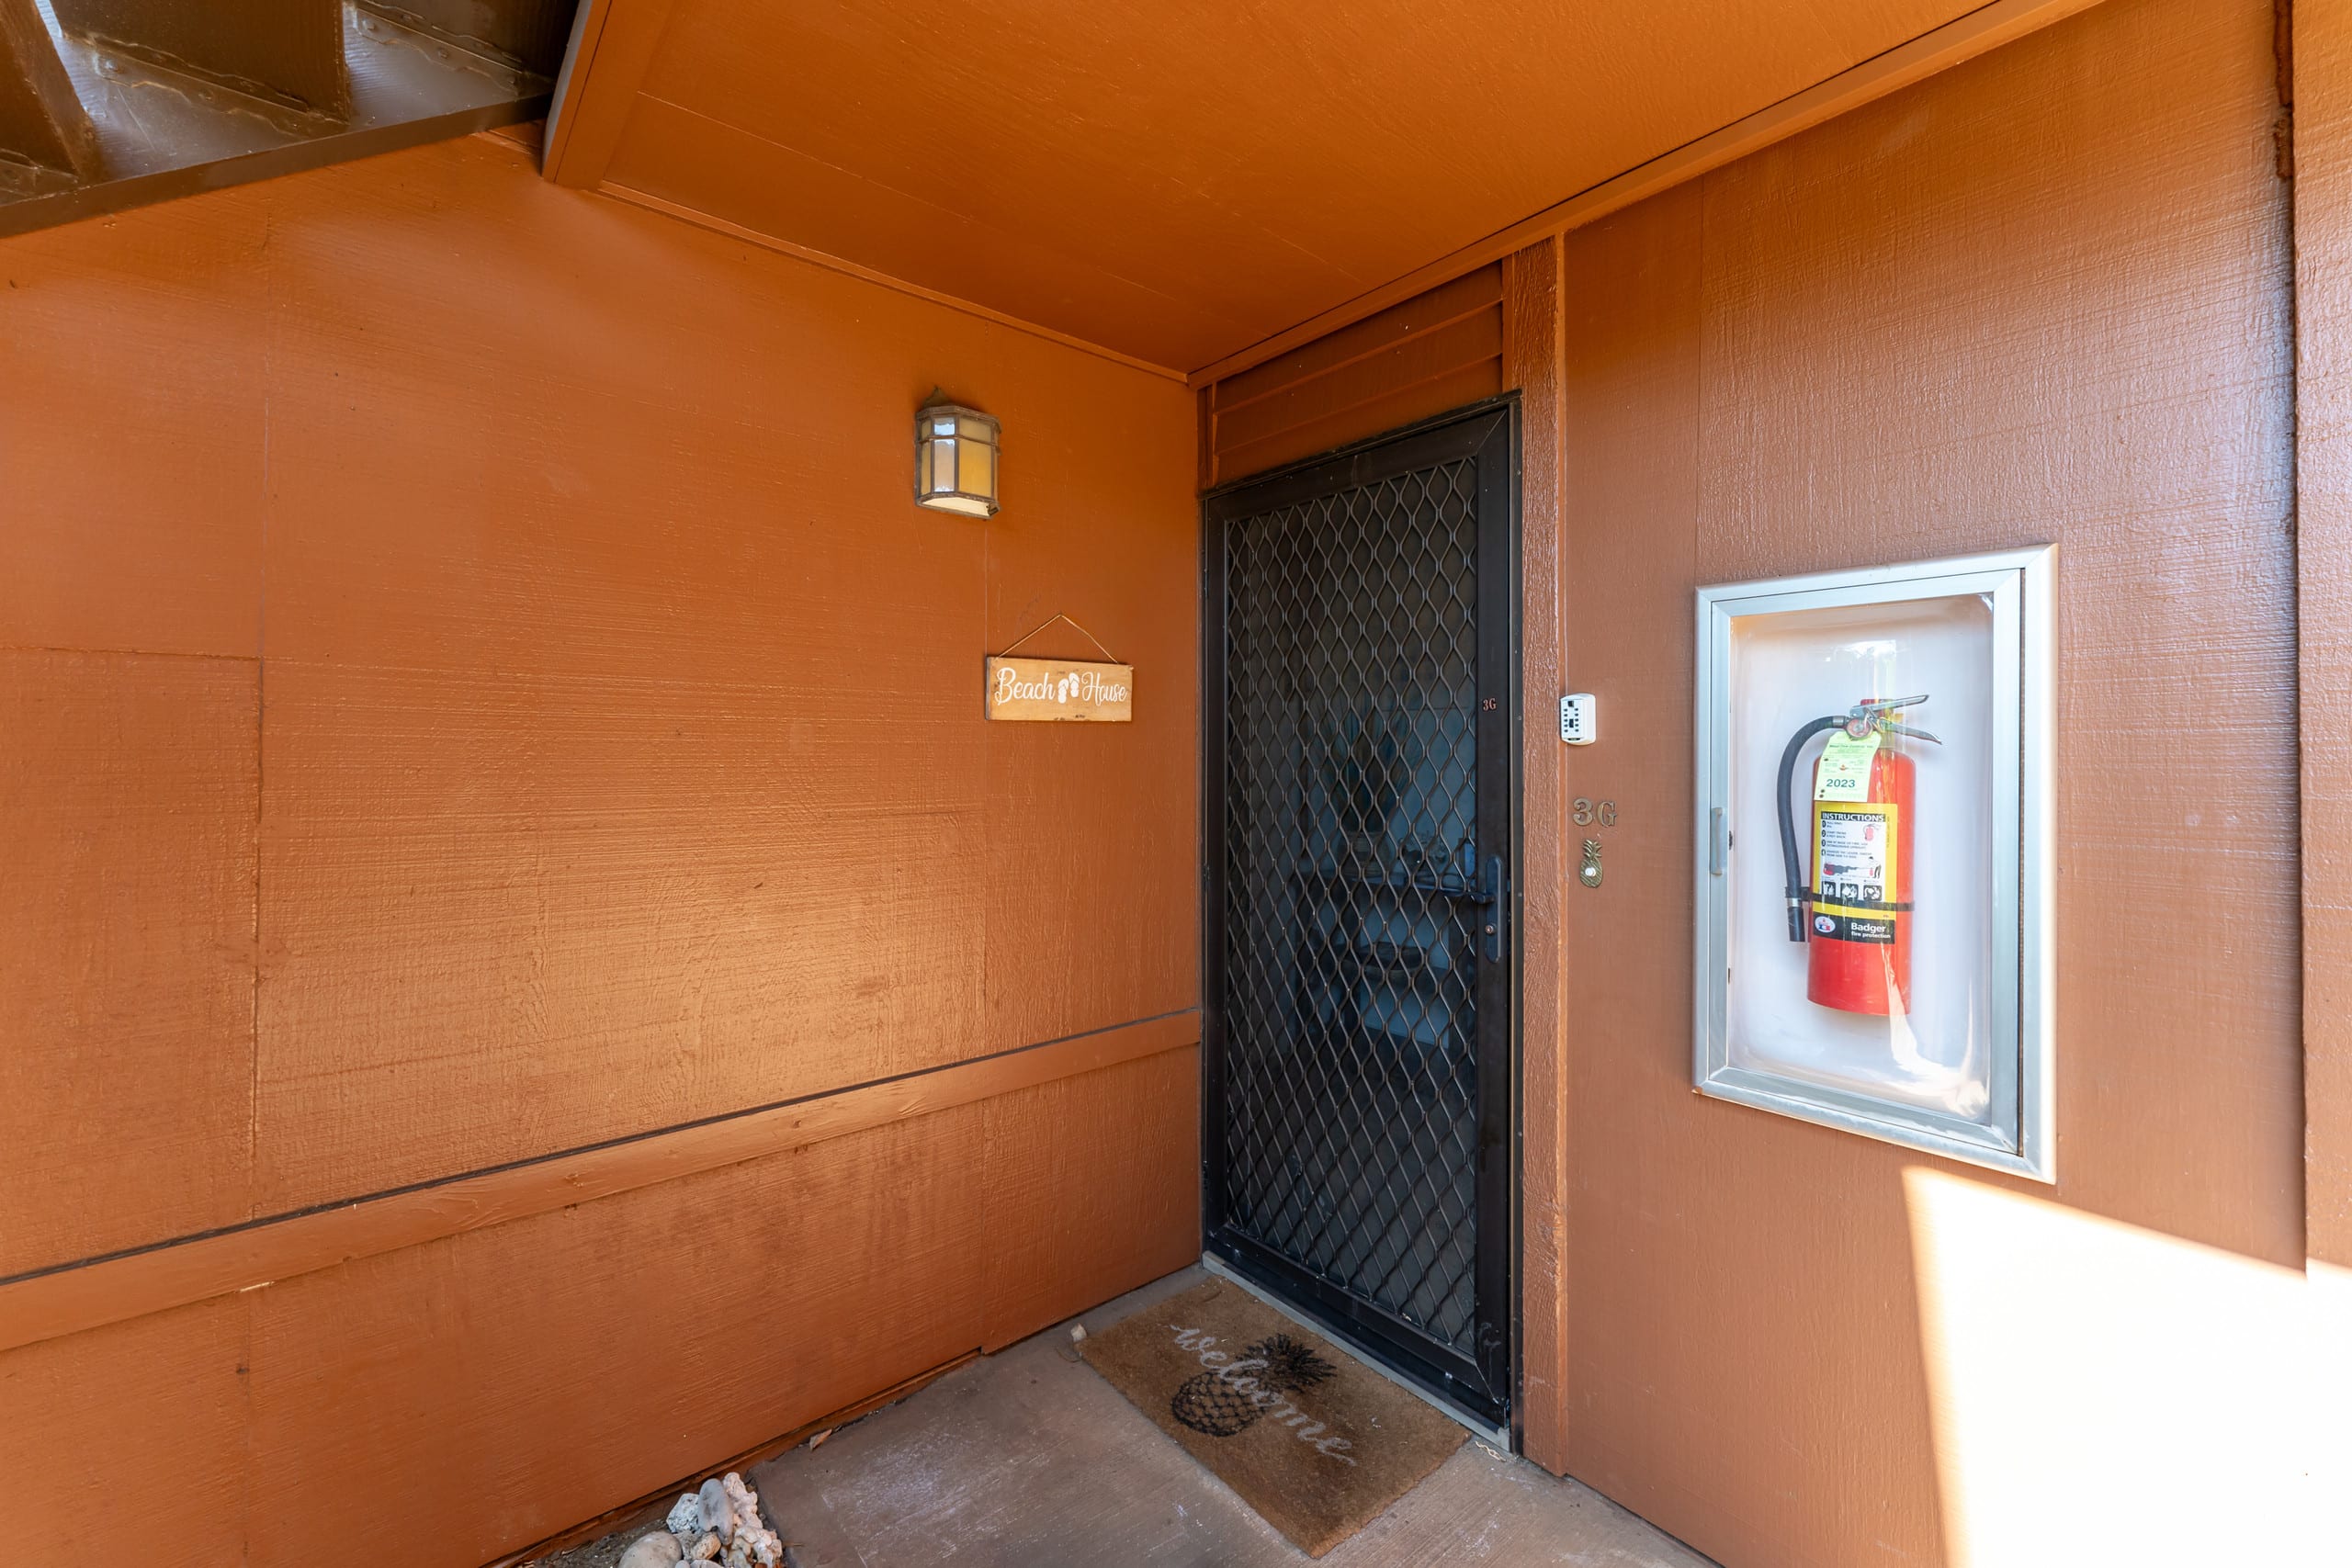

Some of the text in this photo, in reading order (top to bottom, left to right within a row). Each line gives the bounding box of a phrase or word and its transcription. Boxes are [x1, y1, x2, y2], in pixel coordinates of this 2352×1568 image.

[994, 667, 1129, 707] Beach House
[1482, 697, 1498, 711] 3G
[1826, 778, 1856, 788] 2023
[1572, 797, 1618, 828] 3G
[1822, 812, 1884, 822] INSTRUCTIONS
[1850, 922, 1886, 934] Badger
